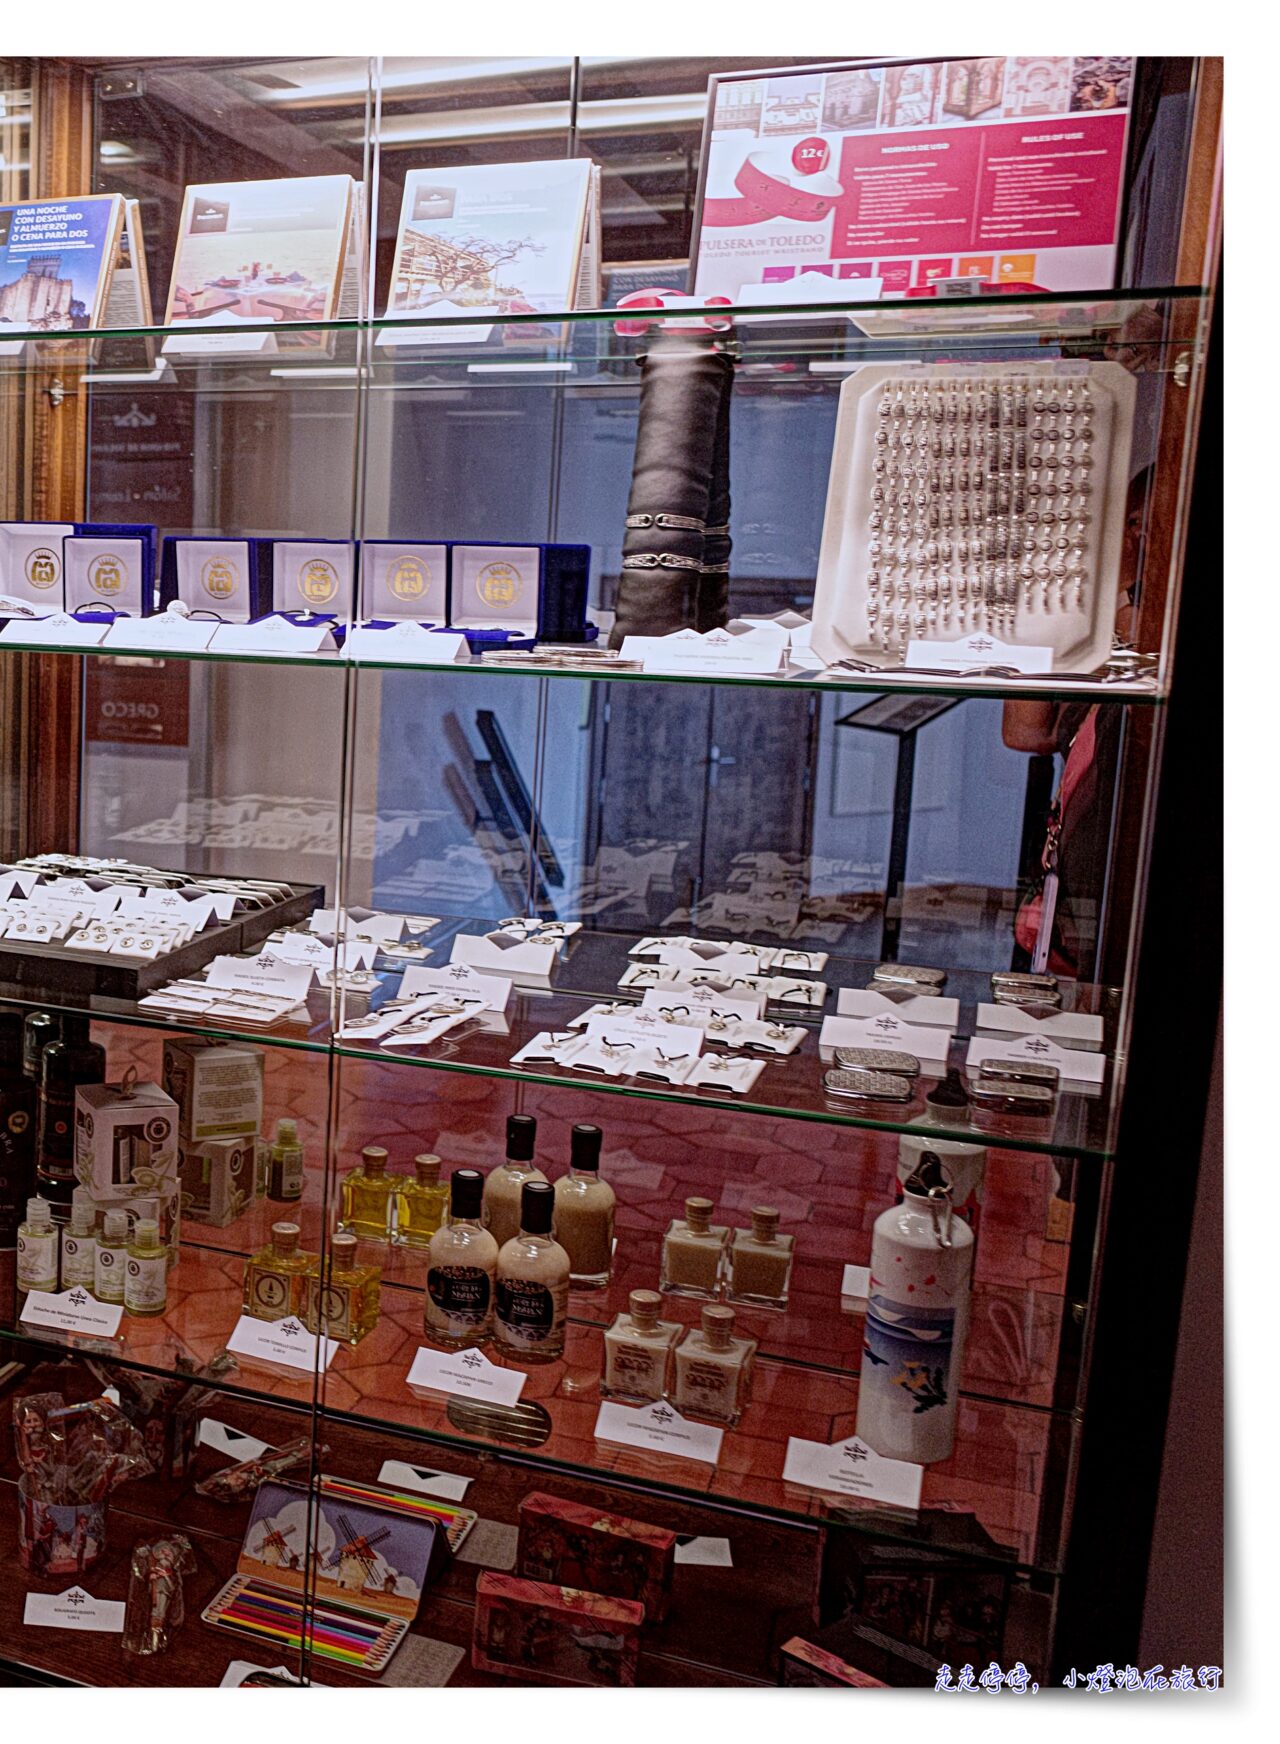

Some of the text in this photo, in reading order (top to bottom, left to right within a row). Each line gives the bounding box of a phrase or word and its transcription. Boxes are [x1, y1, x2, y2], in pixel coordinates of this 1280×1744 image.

[17, 205, 68, 215] UNA NOCHE
[15, 213, 83, 224] CON DESAYUNO
[20, 222, 68, 233] ALMUERZO
[20, 233, 43, 241] CENA
[45, 231, 68, 240] PARA
[69, 230, 88, 238] DOS
[768, 234, 825, 247] TOLEDO
